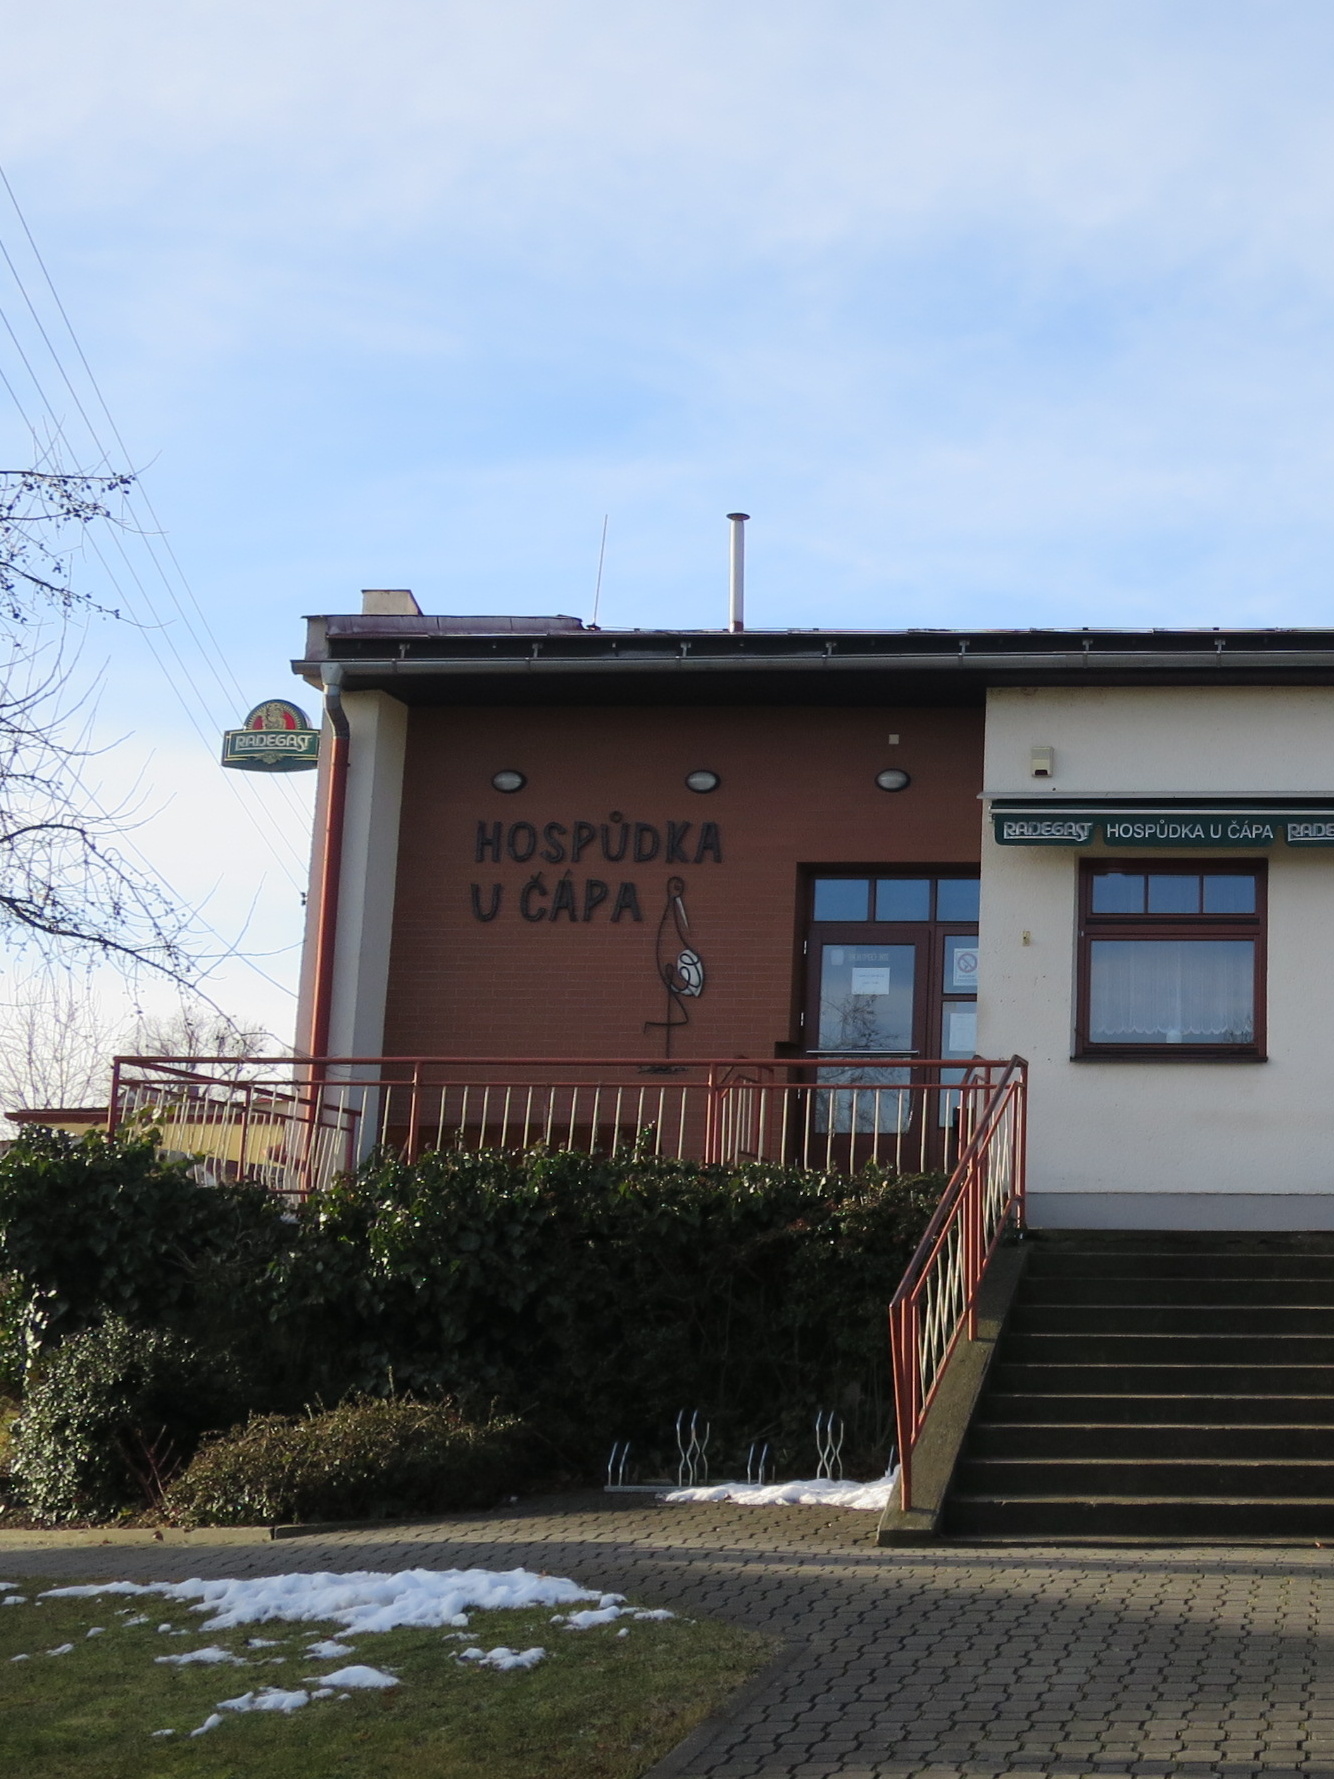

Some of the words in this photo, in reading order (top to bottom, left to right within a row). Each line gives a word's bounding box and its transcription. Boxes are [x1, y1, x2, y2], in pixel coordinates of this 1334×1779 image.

[235, 734, 312, 752] RADEGAST
[474, 810, 723, 864] HOSPŮDKA
[1003, 821, 1093, 842] RADEGAST
[1106, 819, 1205, 839] HOSPŮDKA
[1210, 824, 1222, 839] U
[1227, 820, 1274, 839] ČÁPA
[470, 882, 502, 922] U
[519, 868, 643, 923] ČÁPA
